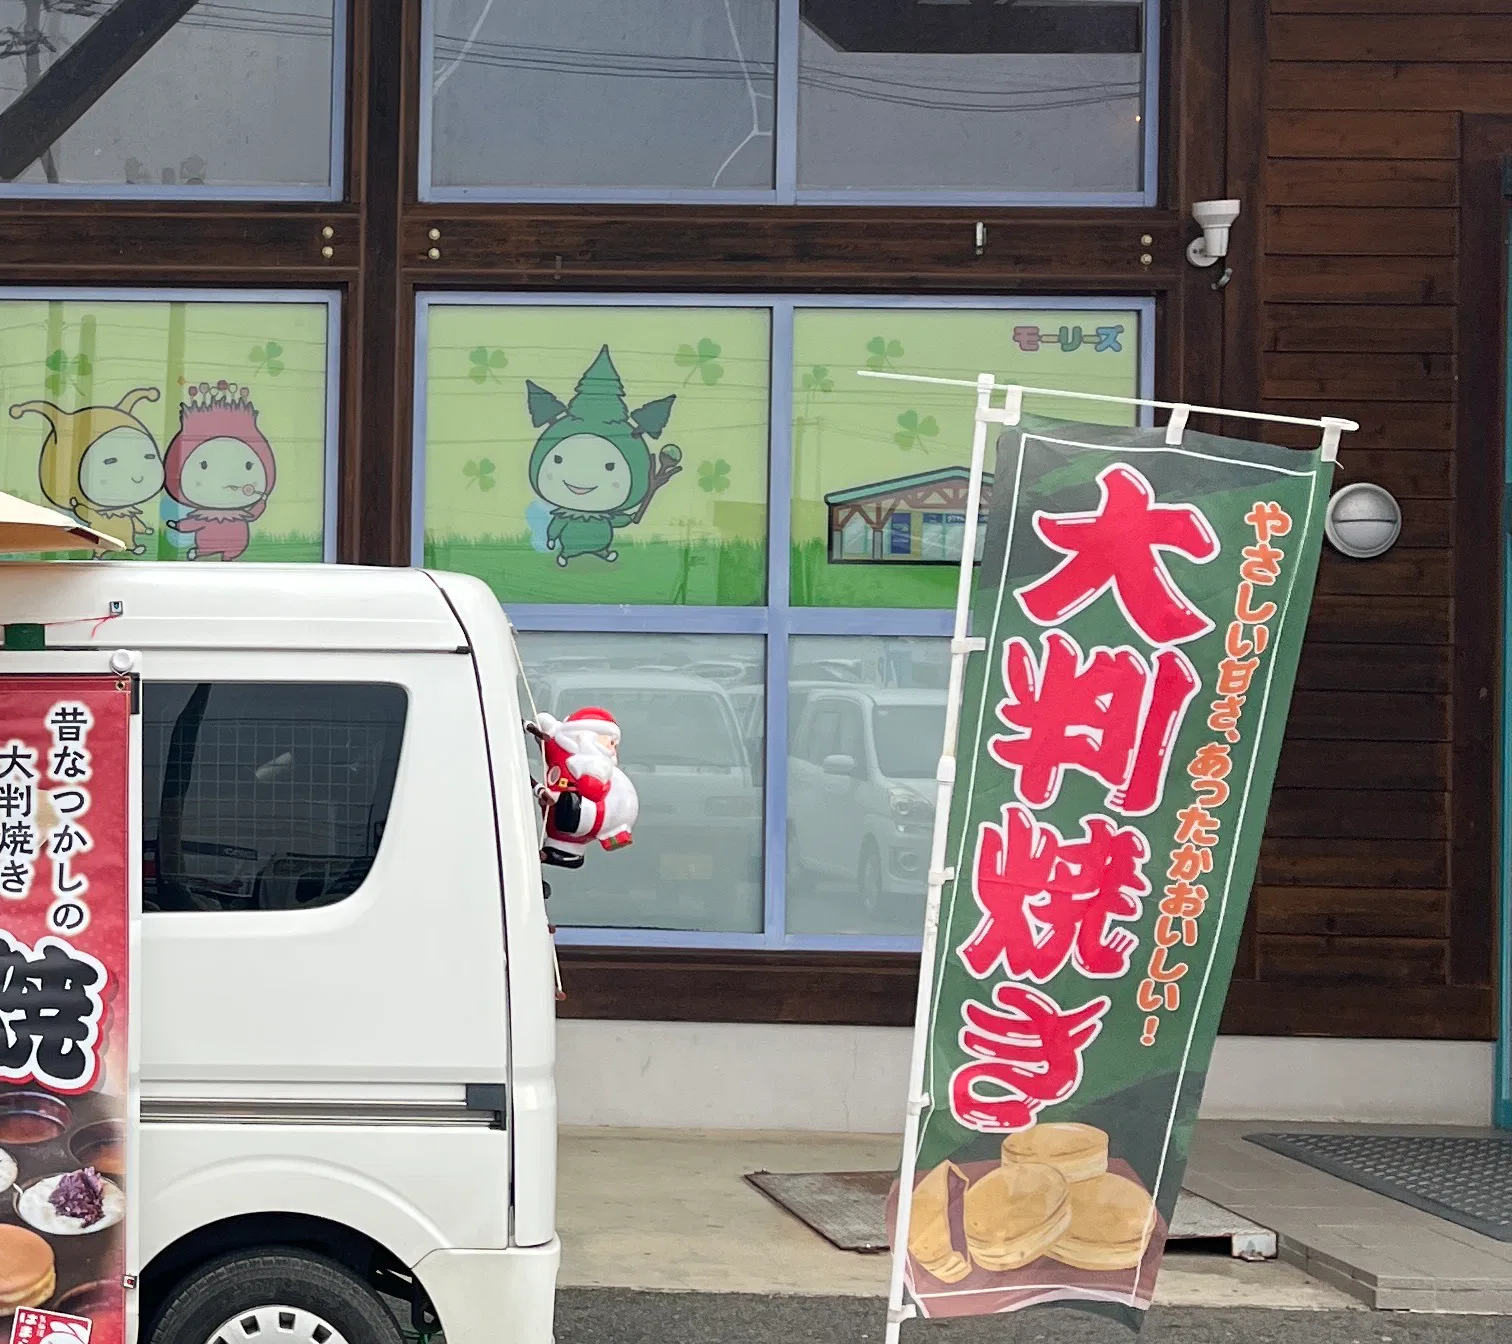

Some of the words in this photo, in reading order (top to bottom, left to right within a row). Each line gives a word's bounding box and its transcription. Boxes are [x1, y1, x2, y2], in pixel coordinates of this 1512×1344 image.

[48, 702, 92, 934] 昔なつかしの
[948, 463, 1221, 1133] 大判焼き
